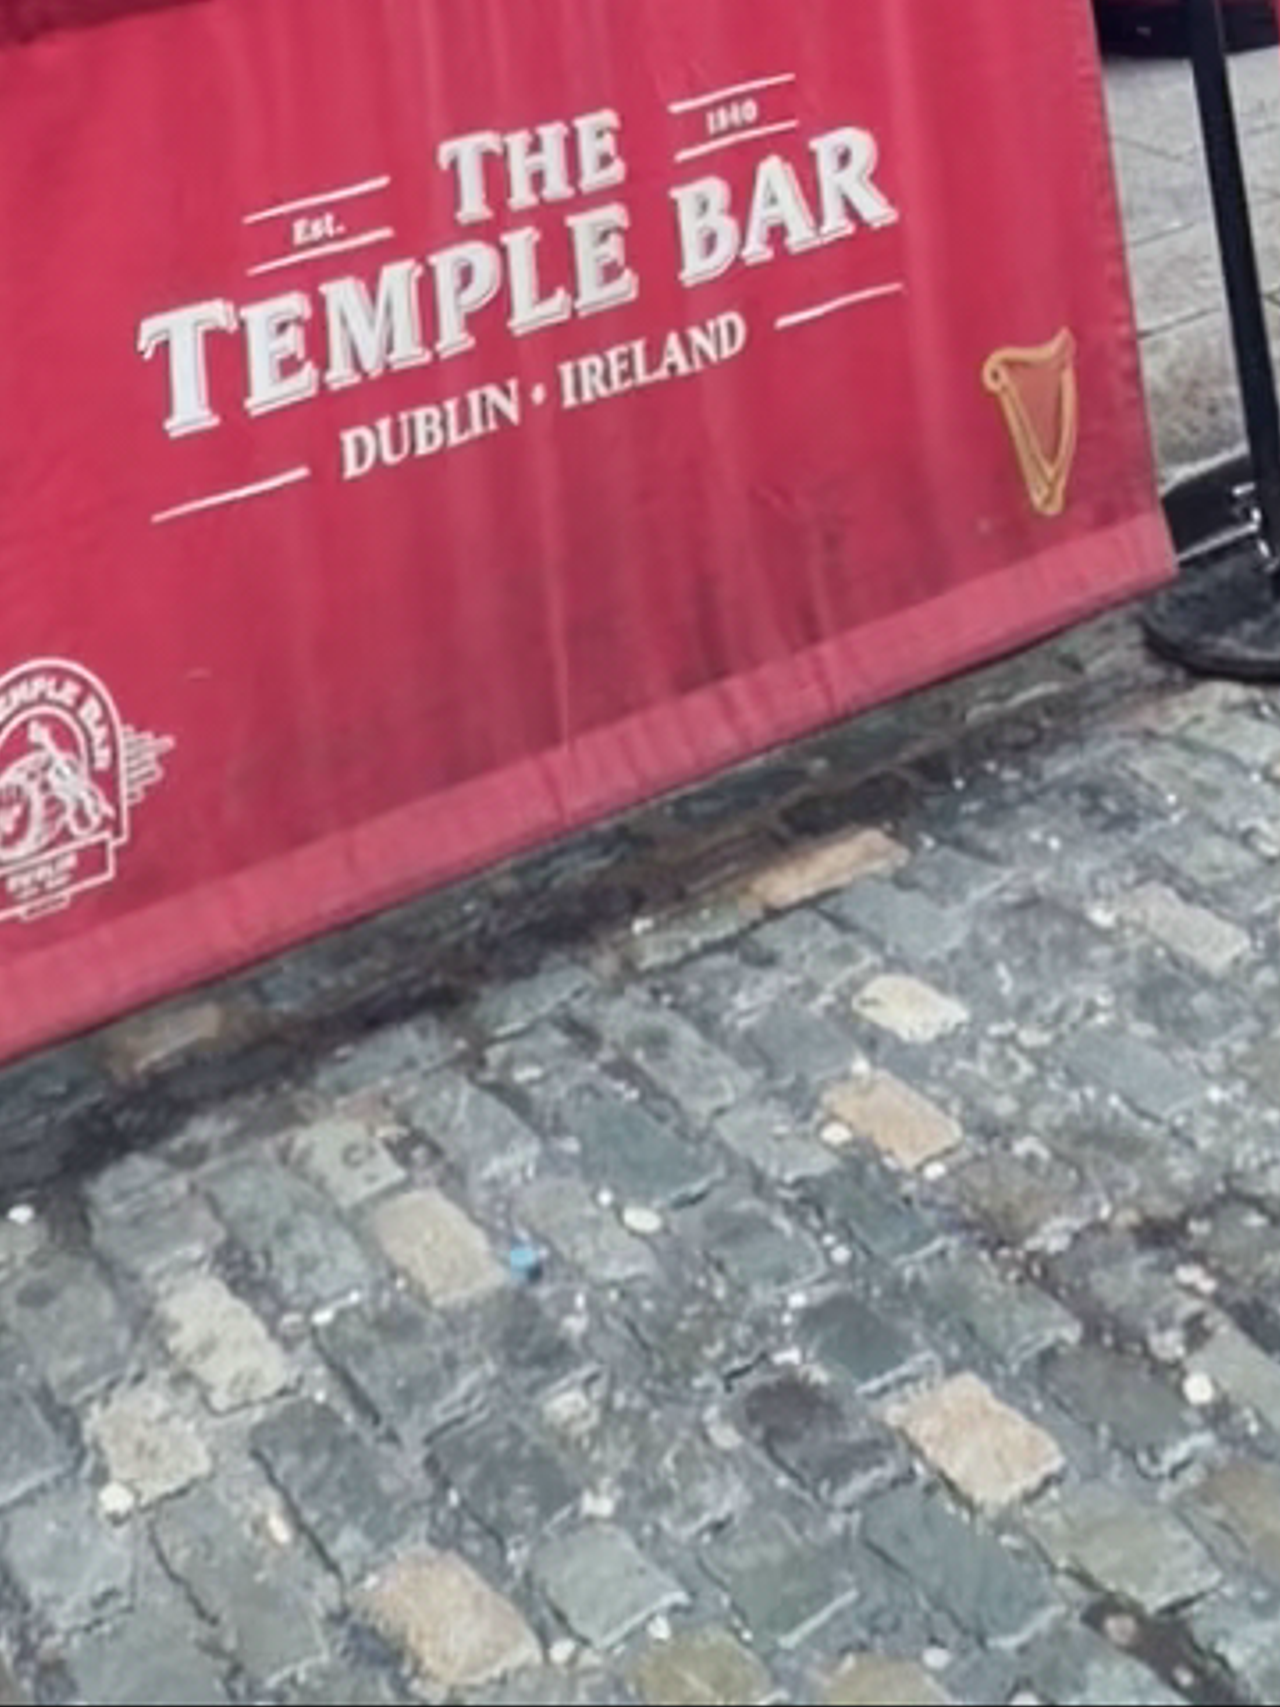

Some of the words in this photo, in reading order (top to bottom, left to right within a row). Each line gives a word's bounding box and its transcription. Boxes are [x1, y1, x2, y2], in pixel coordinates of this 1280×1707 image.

[438, 108, 626, 224] THE
[136, 203, 640, 439] TEMPLE
[667, 126, 900, 287] BAR
[291, 212, 346, 246] Est.
[339, 379, 521, 480] DUBLIN
[557, 310, 748, 410] IRELAND
[77, 694, 113, 771] BAR
